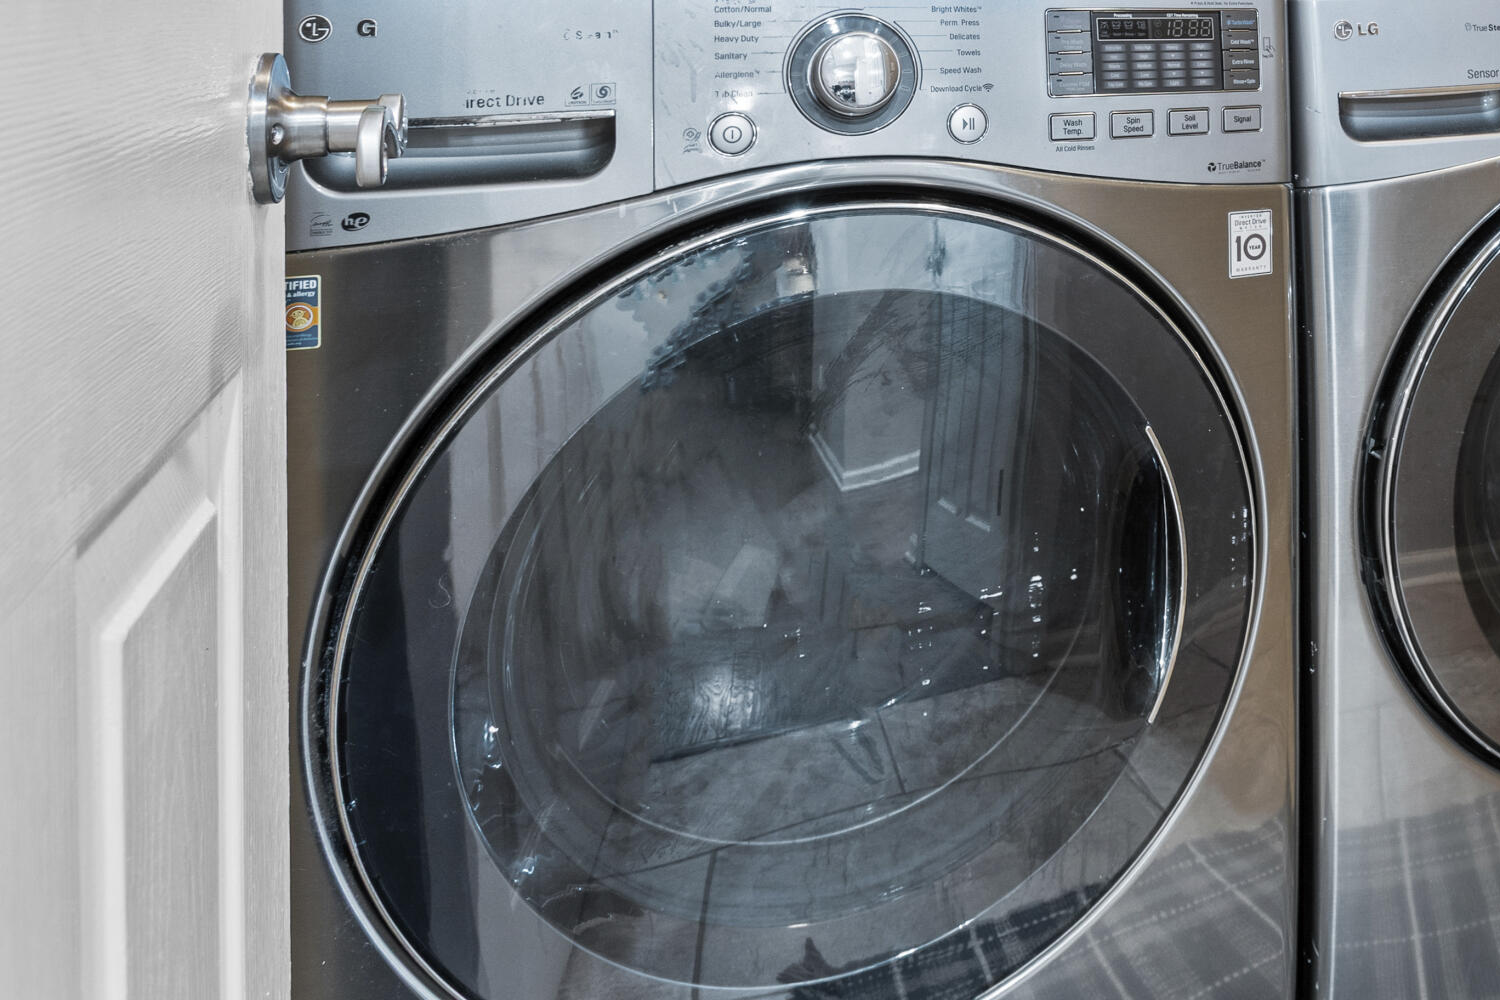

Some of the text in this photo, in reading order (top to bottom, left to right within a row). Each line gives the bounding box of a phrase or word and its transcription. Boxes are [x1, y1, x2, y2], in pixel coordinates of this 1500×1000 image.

[931, 5, 952, 14] Bright
[714, 19, 762, 29] Bulky/Large
[961, 18, 980, 26] Press
[1357, 22, 1379, 36] LG
[714, 34, 760, 43] Heavy Duty
[714, 52, 748, 61] Sanitary
[957, 48, 981, 56] Towels
[940, 66, 982, 75] Speed Wash
[1467, 69, 1498, 80] Sensor
[930, 84, 982, 93] Download Cycle
[463, 94, 545, 109] irect Drive
[1126, 116, 1141, 125] Spin
[1184, 114, 1196, 122] Soil
[1233, 115, 1252, 124] Signal
[1063, 119, 1082, 127] Wash
[1181, 122, 1199, 130] Level
[1063, 127, 1084, 136] Temp.
[1123, 125, 1144, 134] Speed
[1235, 233, 1267, 262] 10
[285, 280, 317, 291] TIFIED
[293, 290, 316, 298] allergy
